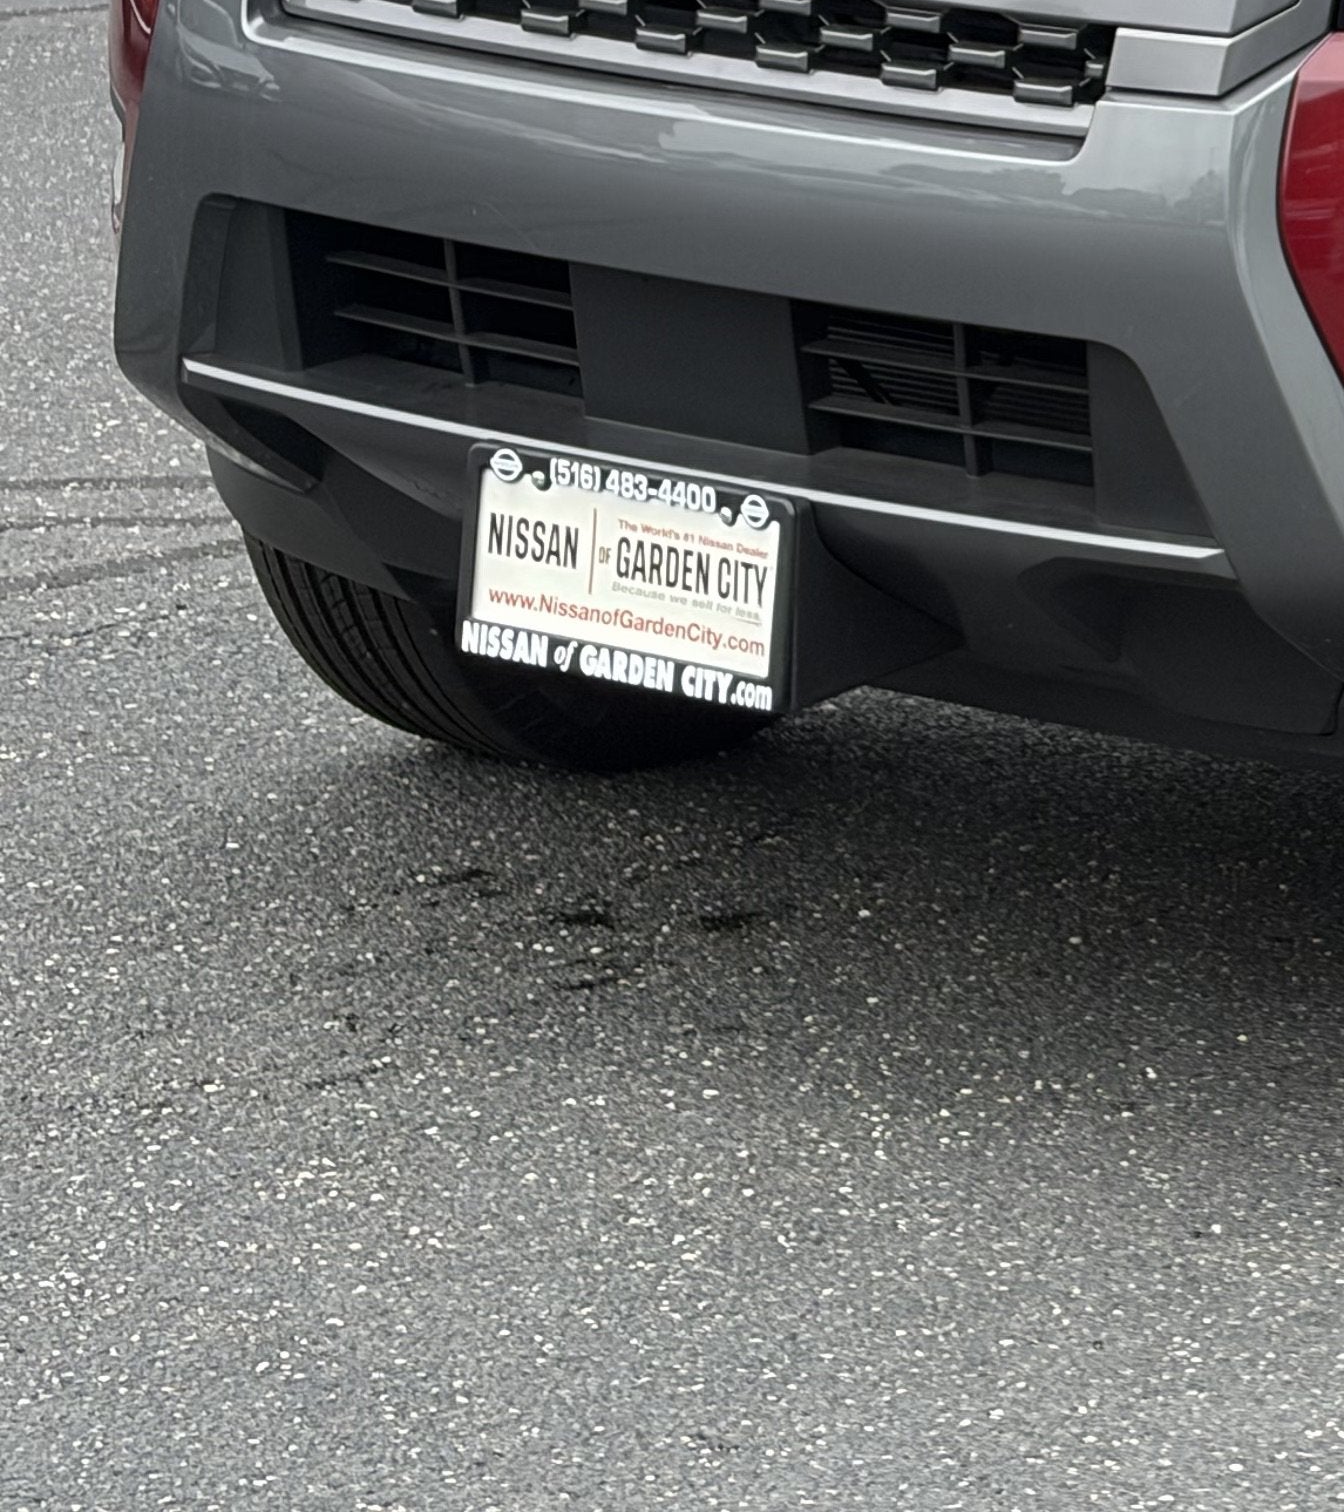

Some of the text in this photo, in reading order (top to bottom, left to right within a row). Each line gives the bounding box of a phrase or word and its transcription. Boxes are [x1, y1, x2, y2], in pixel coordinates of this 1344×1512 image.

[550, 457, 716, 513] (516) 483-4400
[488, 512, 768, 608] NISSAN OF GARDEN CITY
[618, 518, 639, 533] The
[641, 523, 681, 541] World's
[699, 535, 734, 551] Nissan
[736, 542, 769, 559] Dealer
[488, 588, 765, 656] www.NissanofGardenCity.com
[611, 581, 666, 601] Because
[669, 594, 688, 606] we
[716, 603, 732, 615] for
[461, 619, 773, 711] NISSAN of GARDEN CITY.com
